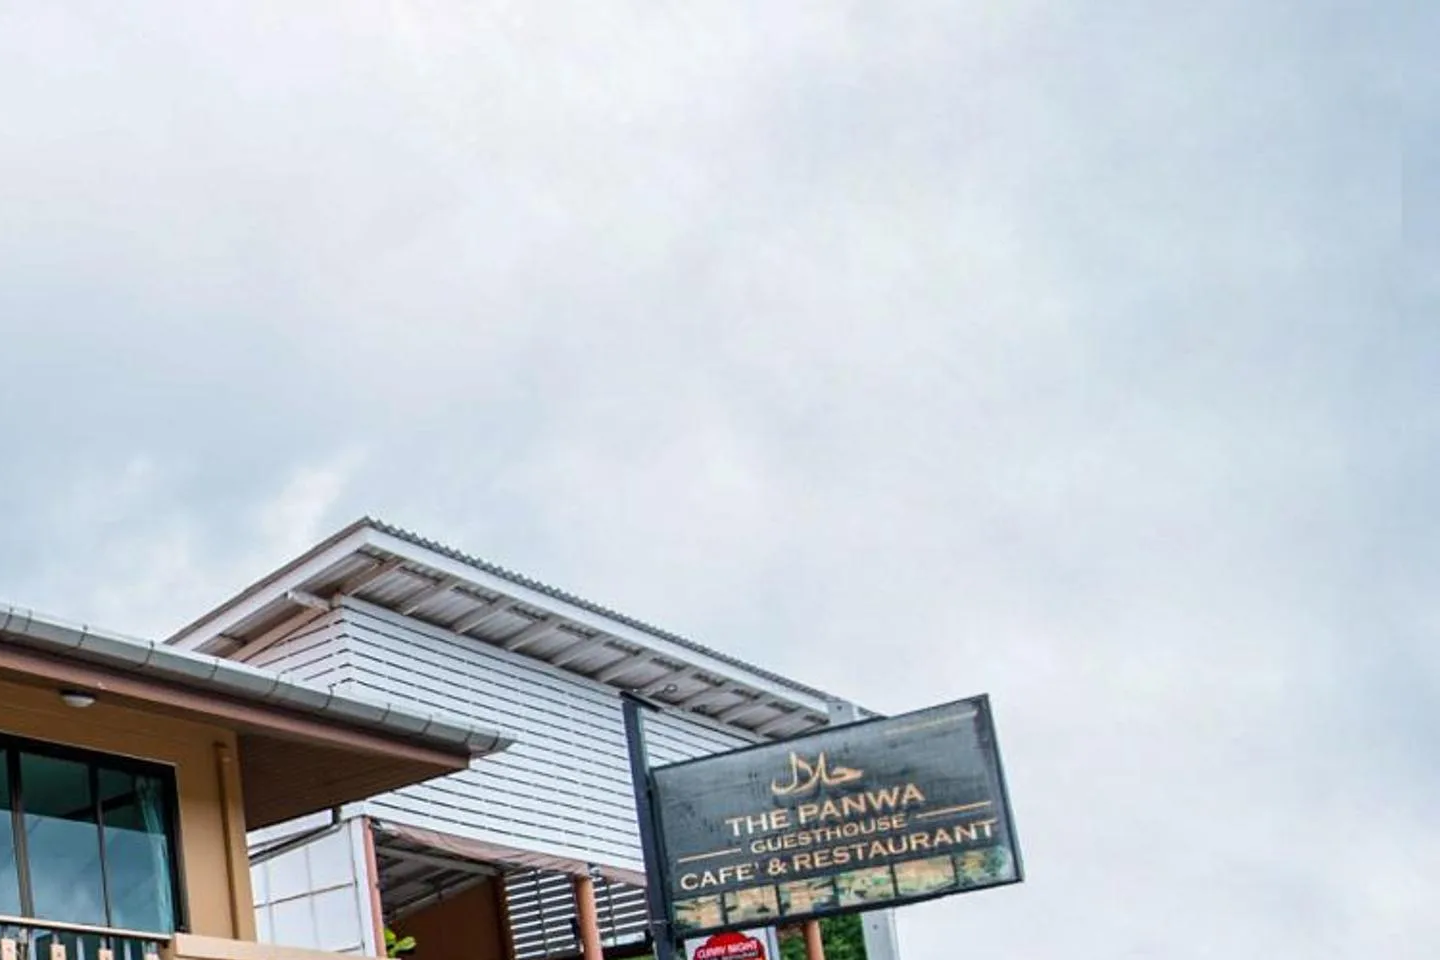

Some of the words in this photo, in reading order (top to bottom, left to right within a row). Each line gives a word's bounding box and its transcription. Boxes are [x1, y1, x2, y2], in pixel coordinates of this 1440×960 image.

[771, 751, 864, 796] حلال
[726, 807, 788, 838] THE
[798, 783, 925, 826] PANWA
[750, 813, 907, 854] GUESTHOUSE
[767, 858, 789, 876] &
[794, 818, 998, 871] RESTAURANT
